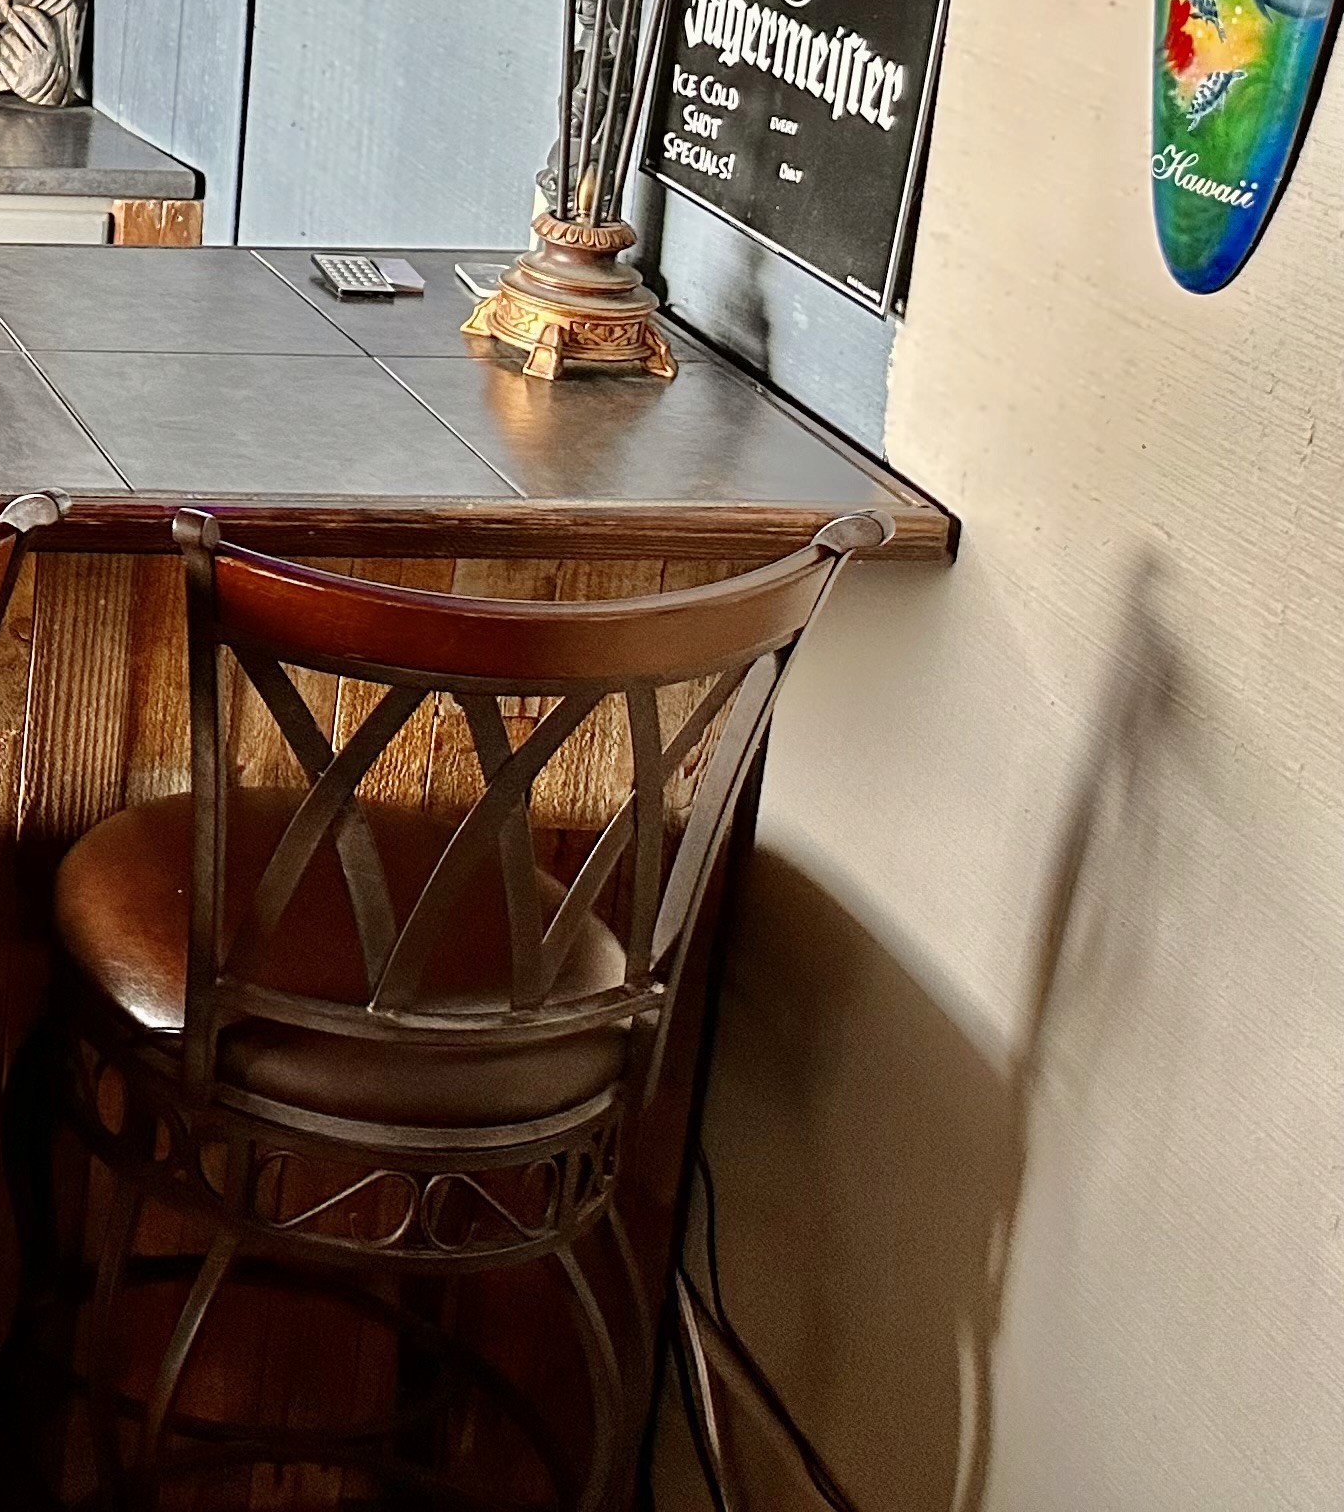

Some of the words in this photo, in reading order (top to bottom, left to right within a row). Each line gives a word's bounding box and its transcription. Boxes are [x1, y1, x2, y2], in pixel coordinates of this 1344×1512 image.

[682, 104, 723, 140] SHOT
[769, 116, 799, 136] EVERY
[663, 131, 736, 180] SPECIALS!
[1151, 144, 1259, 209] Hawaii
